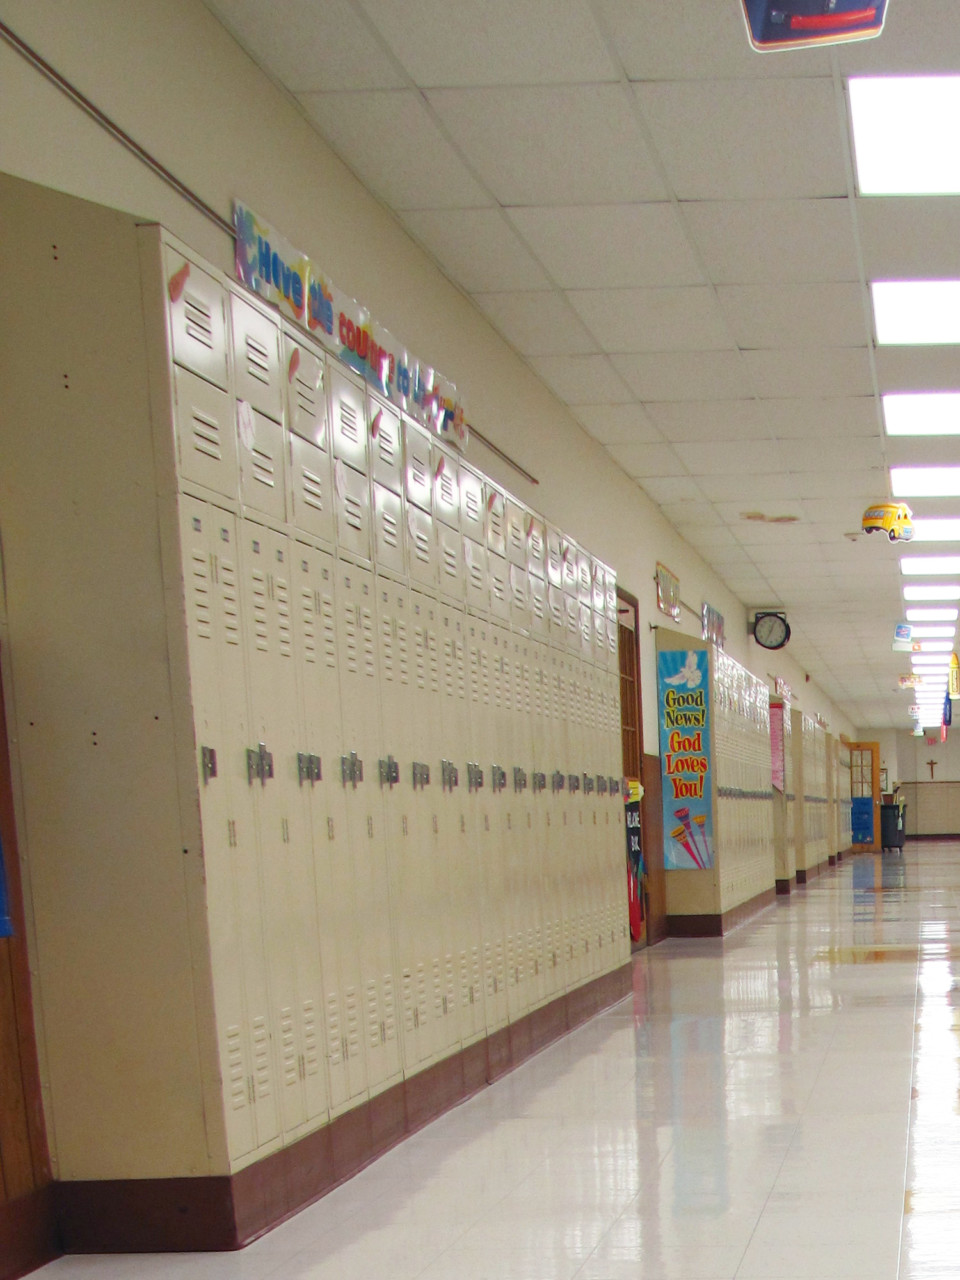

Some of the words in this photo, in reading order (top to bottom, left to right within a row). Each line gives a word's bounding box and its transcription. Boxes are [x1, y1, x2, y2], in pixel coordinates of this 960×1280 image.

[665, 688, 705, 709] Good
[664, 708, 707, 729] News!
[669, 730, 703, 754] God
[664, 752, 709, 776] Loves
[670, 773, 705, 800] You!
